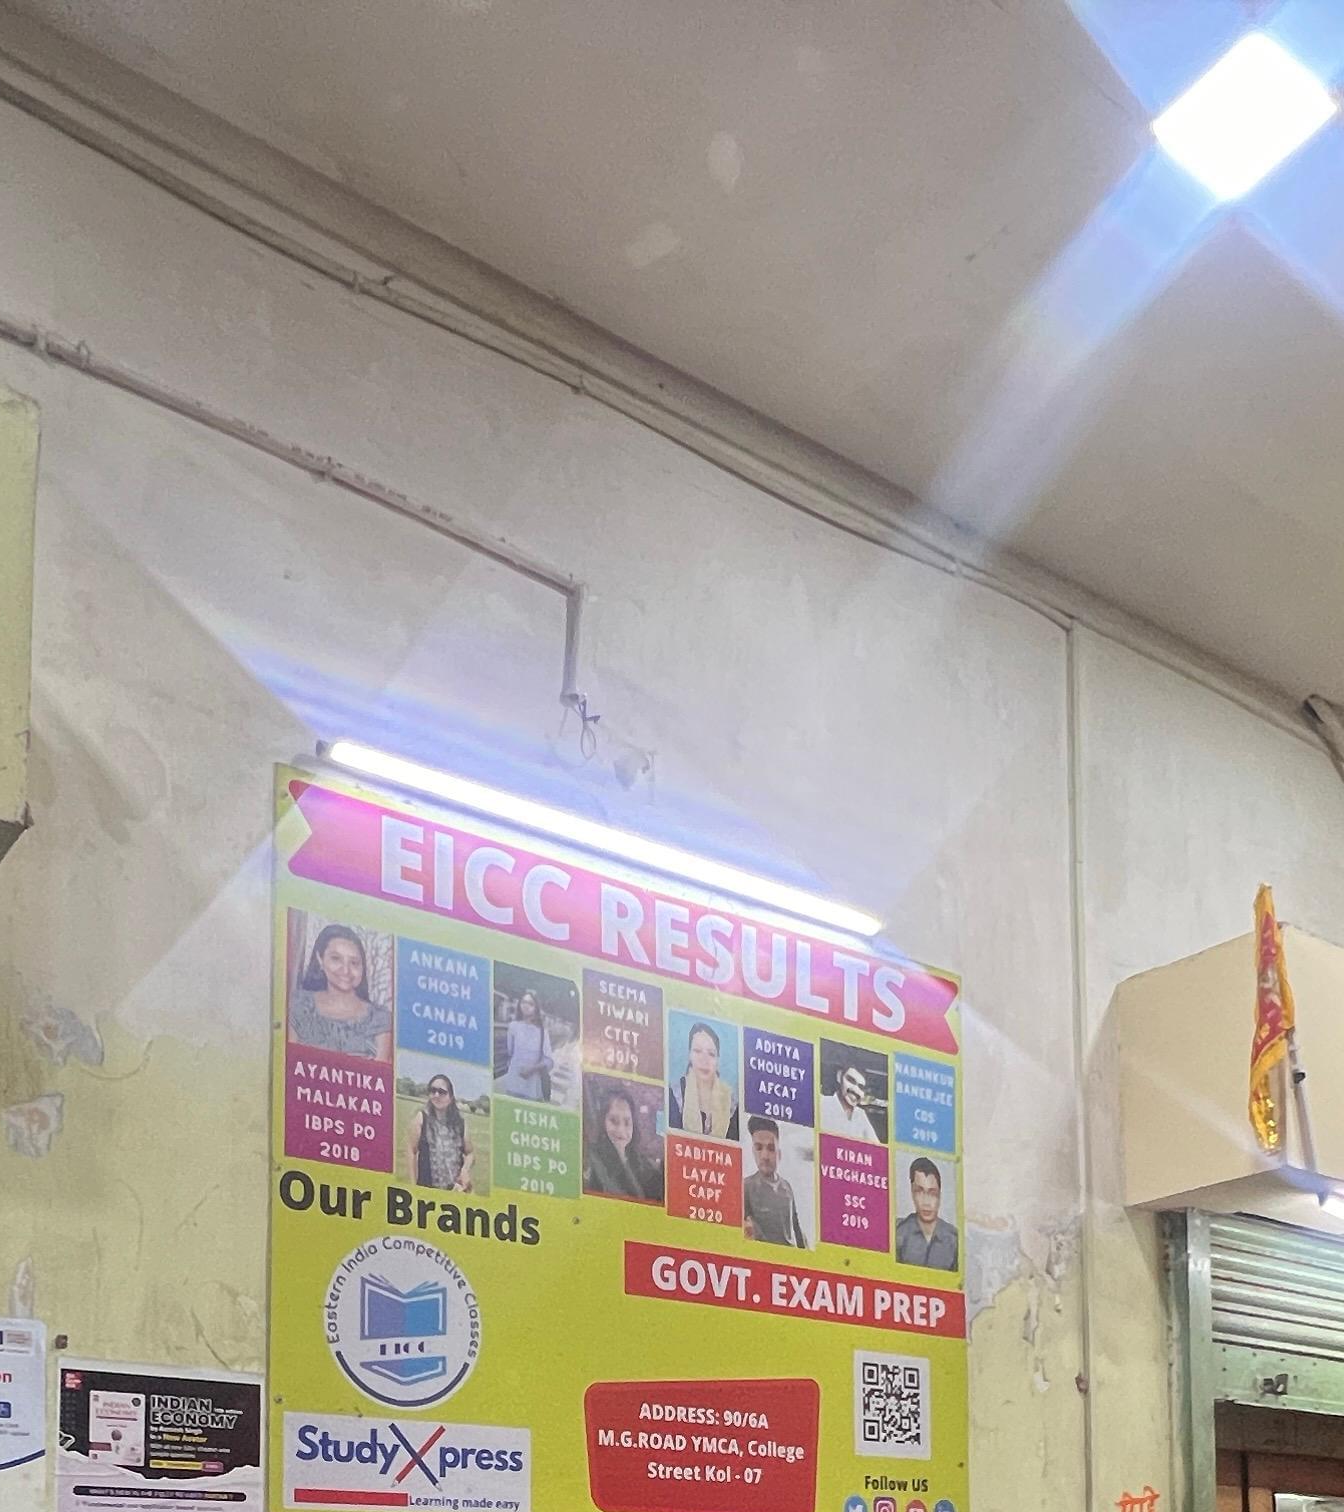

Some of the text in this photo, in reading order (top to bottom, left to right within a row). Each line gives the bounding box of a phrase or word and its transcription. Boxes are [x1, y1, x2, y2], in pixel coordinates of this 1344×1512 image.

[380, 815, 908, 1034] EICC RESULTS
[410, 950, 479, 981] ANKANA
[417, 975, 471, 1001] GHOSH
[599, 981, 647, 1004] SEEMA
[412, 1002, 479, 1032] CANARA
[598, 1002, 649, 1027] TIWARI
[427, 1029, 465, 1050] 2019
[604, 1028, 640, 1048] CTET
[755, 1038, 801, 1061] ADITYA
[294, 1061, 386, 1093] AYANTIKA
[749, 1058, 806, 1081] CHOUBEY
[296, 1086, 383, 1117] MALAKAR
[758, 1081, 797, 1101] AFCAT
[513, 1108, 559, 1131] TISHA
[764, 1101, 793, 1120] 2019
[305, 1115, 376, 1141] IBPS PO
[320, 1142, 360, 1162] 2018
[510, 1131, 561, 1153] GHOSH
[507, 1151, 568, 1176] IBPS PO
[674, 1143, 733, 1168] SABITHA
[836, 1147, 873, 1167] KIRAN
[520, 1177, 555, 1195] 2019
[682, 1166, 726, 1187] LAYAK
[688, 1185, 722, 1203] CAPF
[844, 1195, 866, 1211] SSC
[279, 1170, 541, 1246] Our Brands
[689, 1205, 723, 1224] 2020
[841, 1213, 869, 1230] 2019
[326, 1236, 480, 1358] Eastern India Competitive Classes
[651, 1254, 946, 1328] GOVT. EXAM PREP
[150, 1395, 212, 1413] INDIAN
[150, 1410, 237, 1429] ECONOMY
[638, 1402, 769, 1430] ADDRESS: 90/6A
[598, 1429, 805, 1462] M.G.ROAD YMCA, College
[647, 1461, 701, 1482] Street
[705, 1465, 731, 1483] Kol
[744, 1468, 763, 1485] 07
[864, 1475, 929, 1493] Follow US
[409, 1495, 520, 1512] Learning made easy
